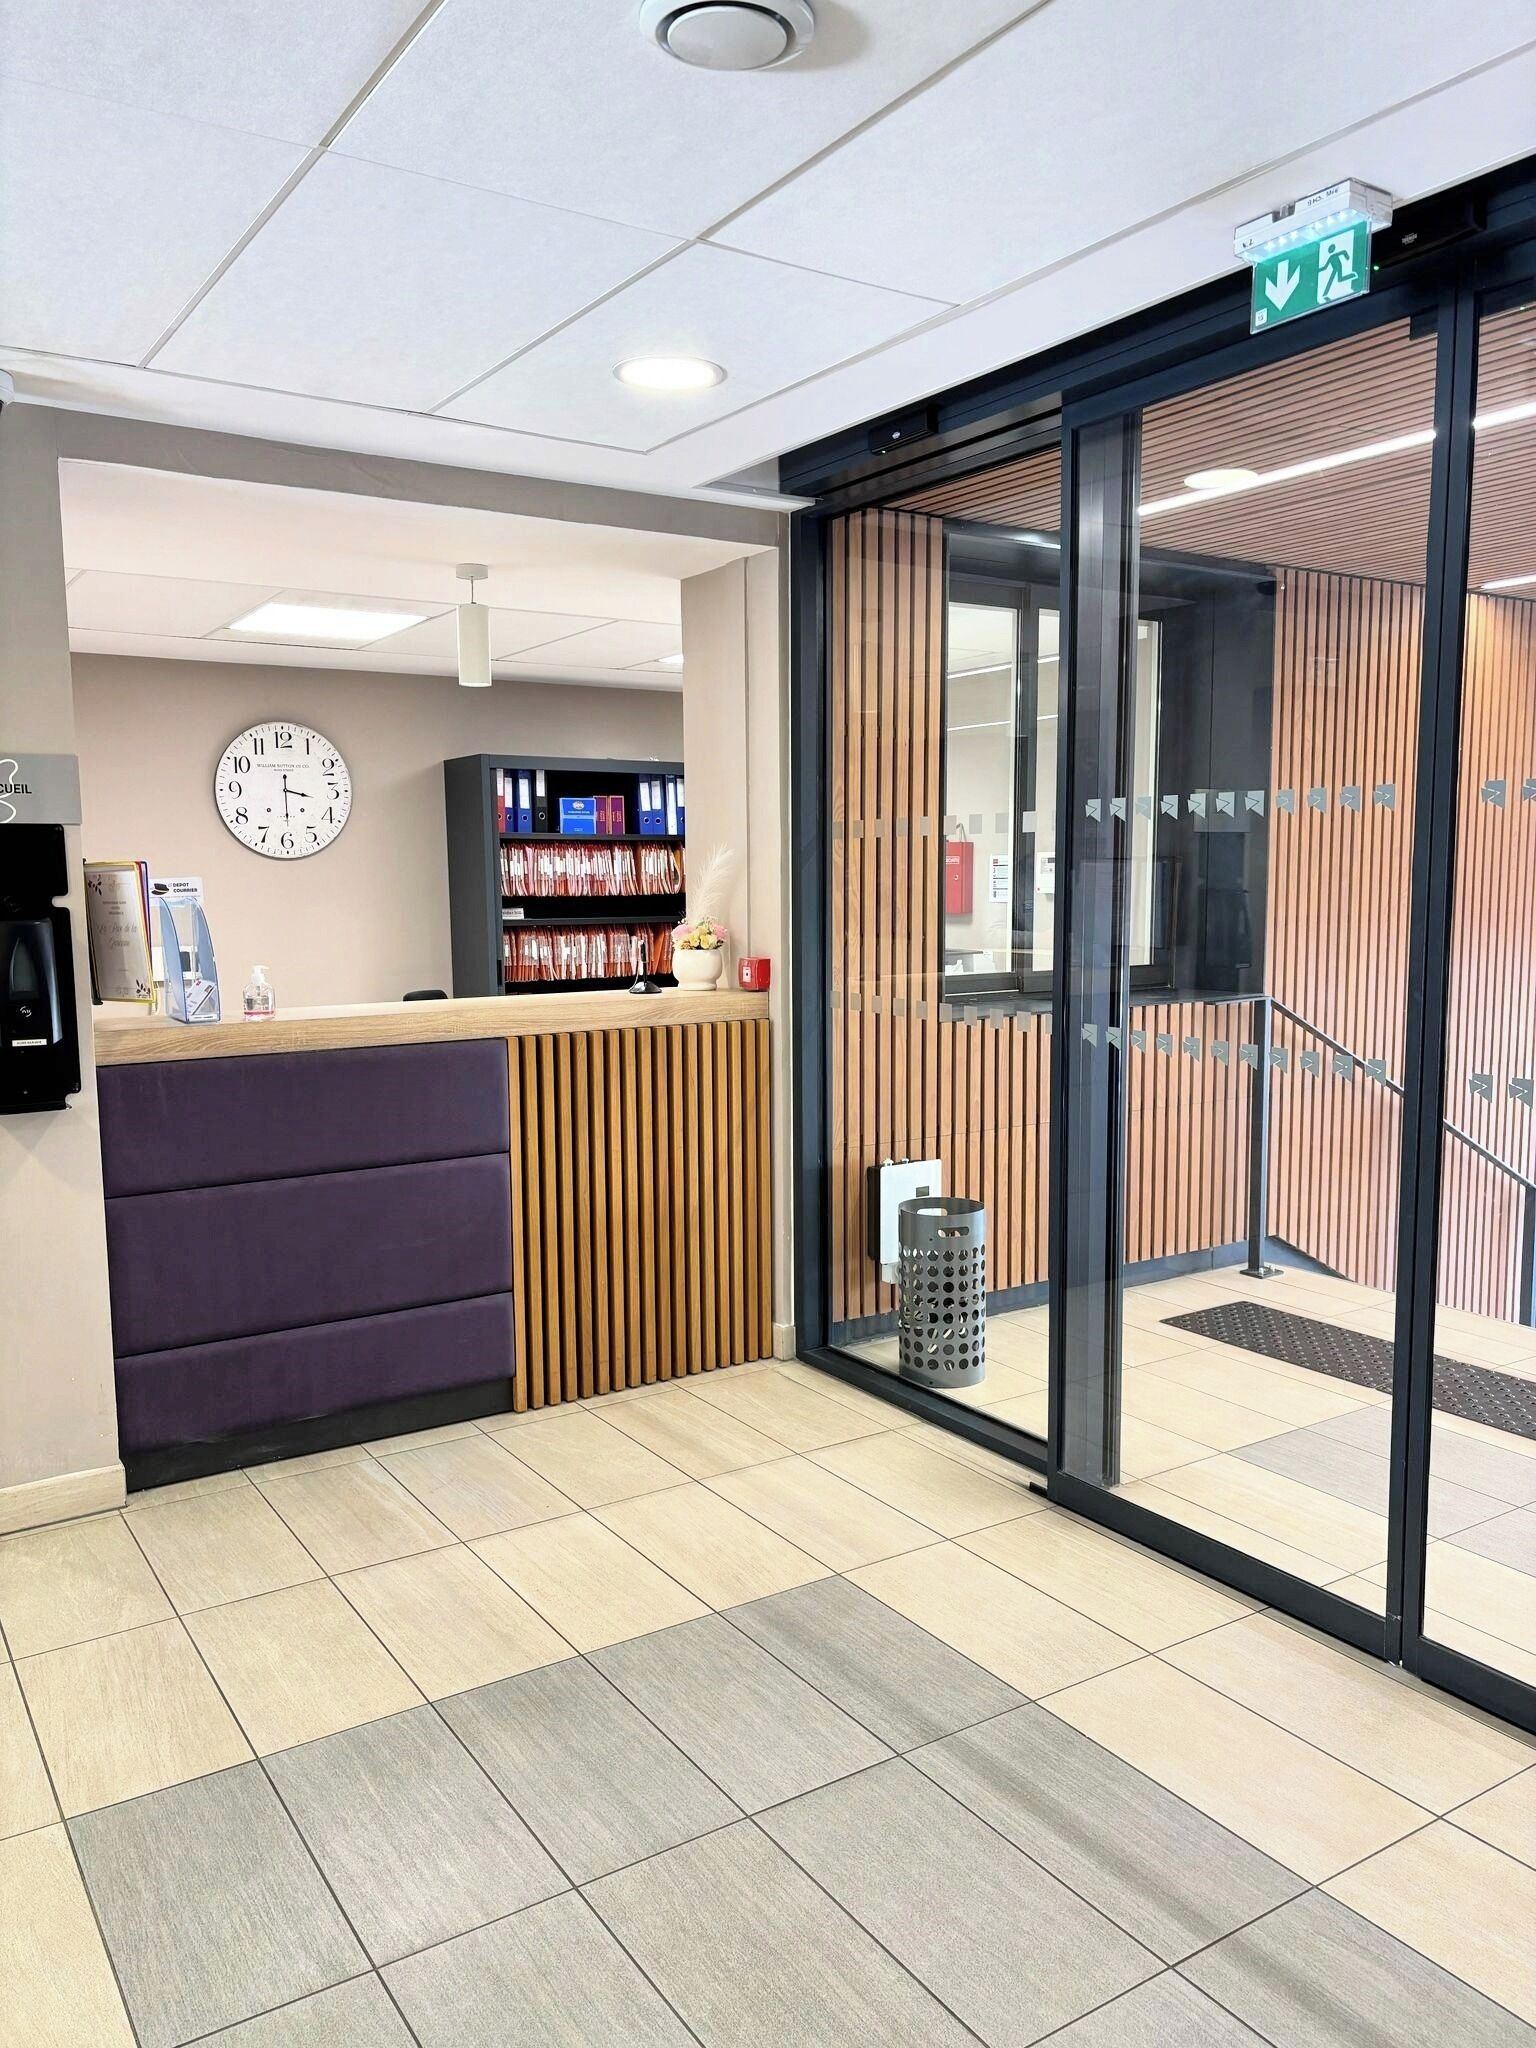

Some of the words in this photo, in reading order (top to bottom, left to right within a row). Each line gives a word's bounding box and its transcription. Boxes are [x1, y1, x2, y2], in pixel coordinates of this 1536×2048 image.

[254, 738, 264, 755] 11
[274, 732, 292, 749] 12
[306, 738, 310, 755] 1
[234, 756, 251, 773] 10
[322, 758, 334, 776] 2
[229, 781, 242, 799] 9
[327, 782, 339, 800] 3
[236, 807, 248, 824] 8
[321, 807, 335, 824] 4
[258, 826, 269, 843] 7
[281, 832, 294, 849] 6
[305, 826, 317, 843] 5
